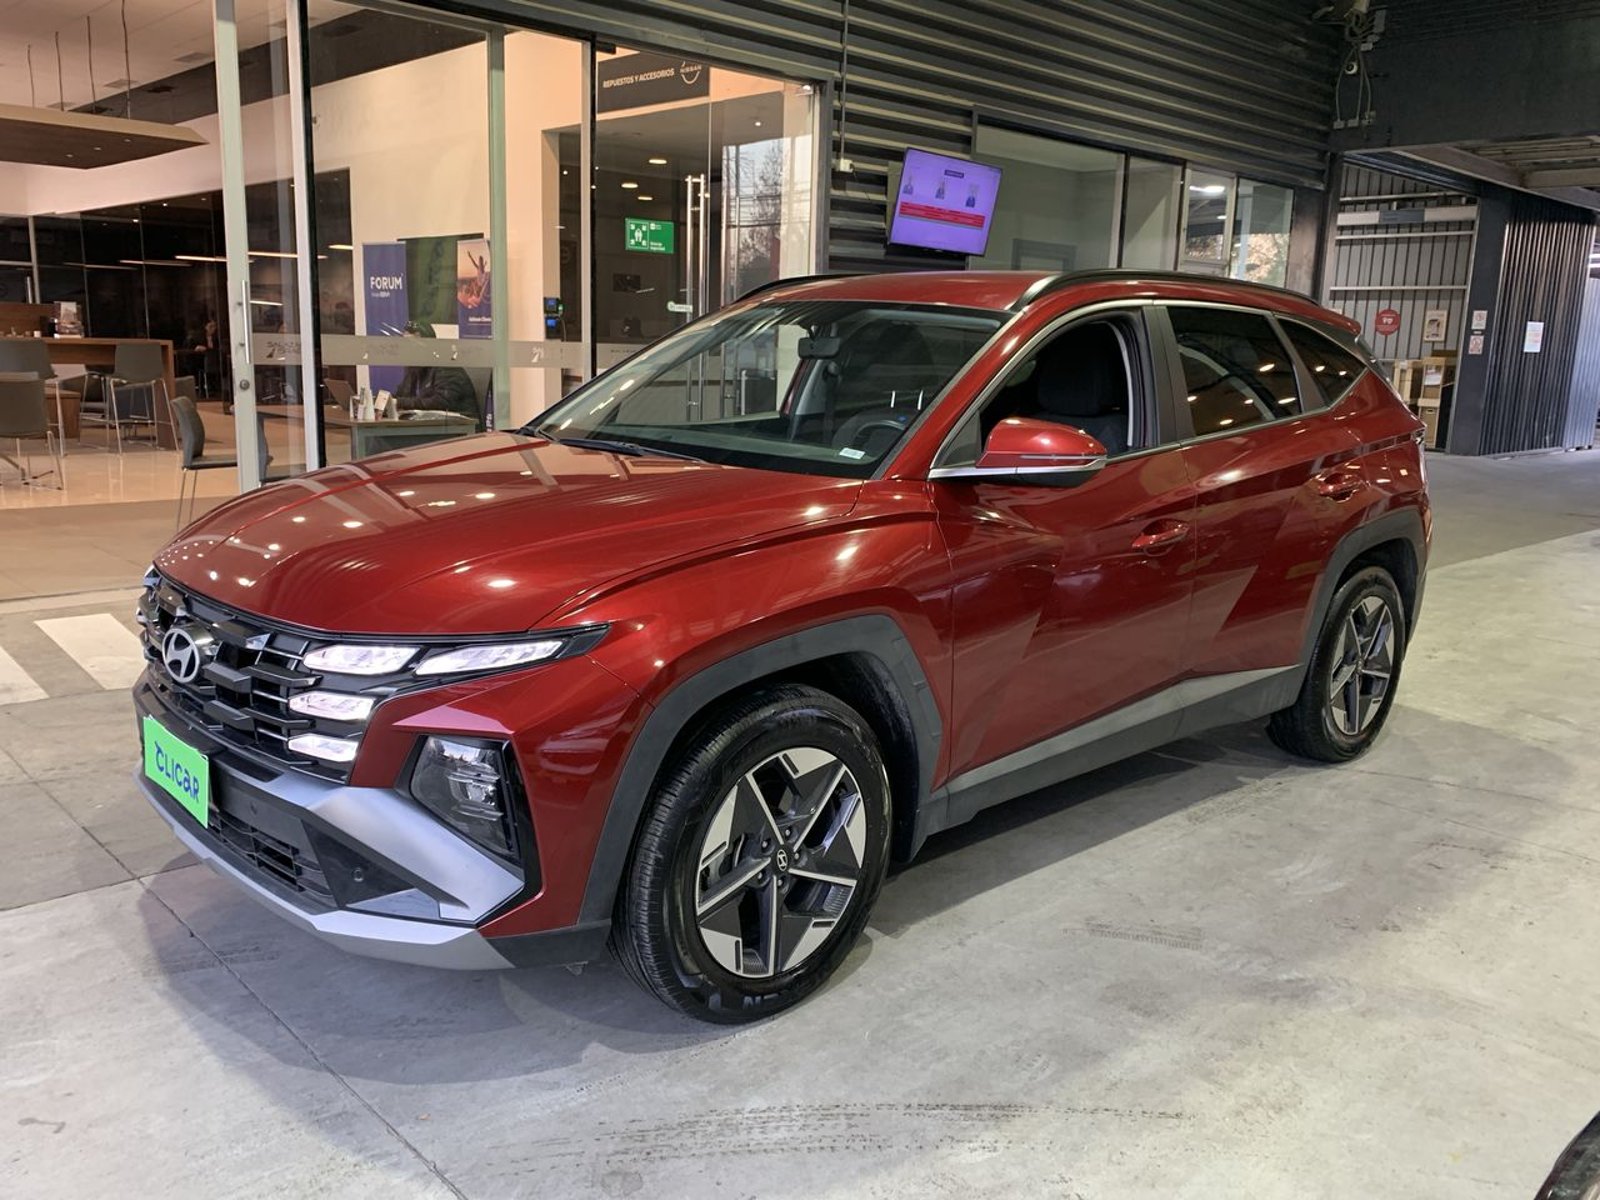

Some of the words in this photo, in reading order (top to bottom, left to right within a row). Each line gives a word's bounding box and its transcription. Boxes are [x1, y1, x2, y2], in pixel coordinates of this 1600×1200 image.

[603, 75, 634, 88] REPUESTOS
[639, 68, 675, 81] ACCESORIOS
[370, 276, 403, 290] FORUM
